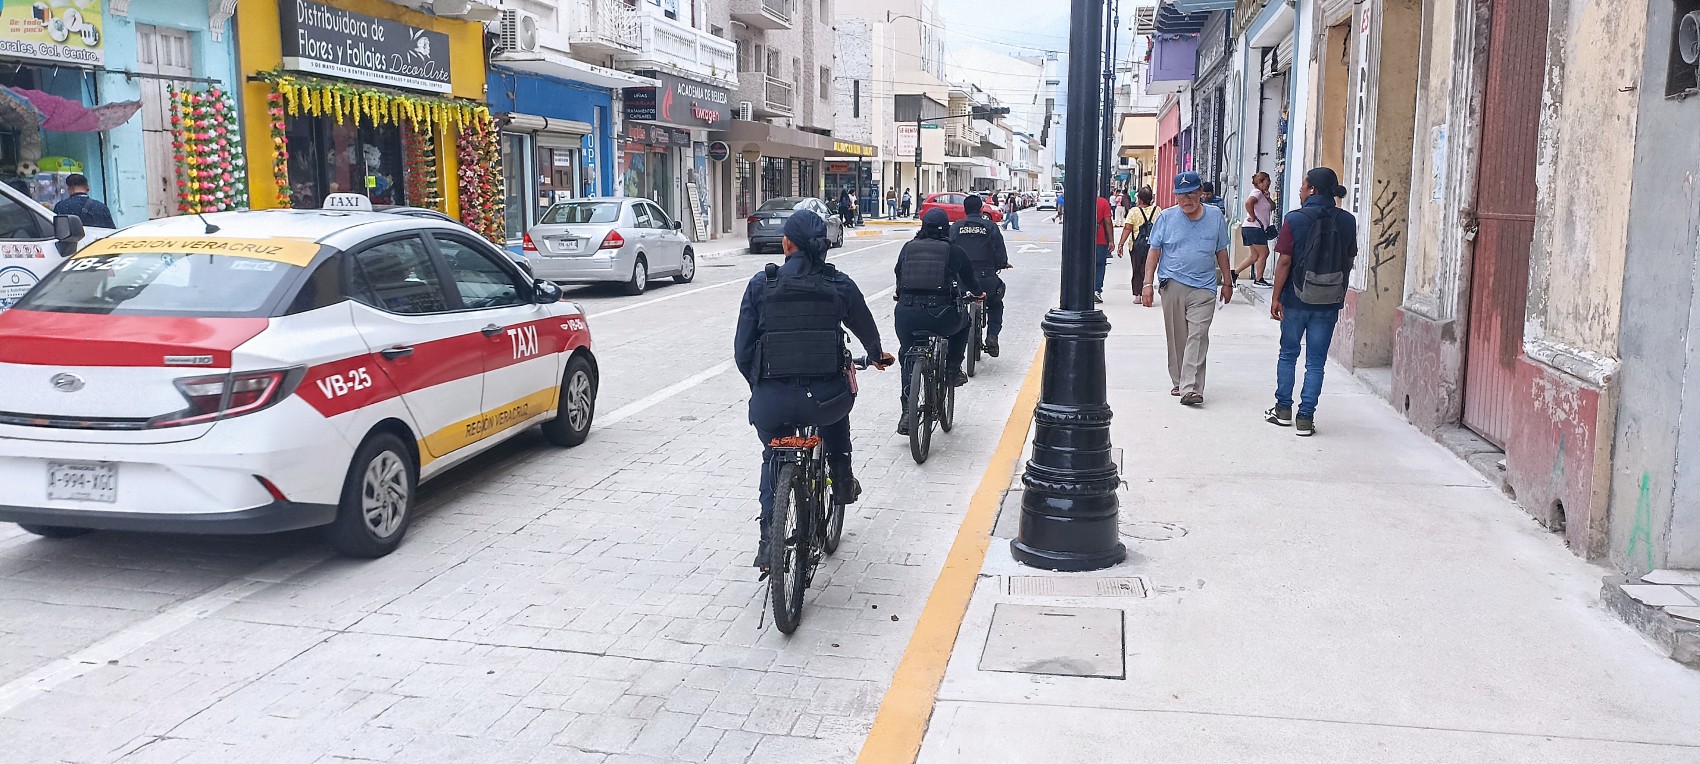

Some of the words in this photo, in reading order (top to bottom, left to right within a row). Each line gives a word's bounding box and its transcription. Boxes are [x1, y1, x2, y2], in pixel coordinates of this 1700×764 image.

[297, 0, 367, 38] Distribuidora
[371, 18, 385, 42] de
[39, 43, 61, 58] Col.
[63, 46, 100, 62] Centro.
[298, 29, 333, 60] Flores
[337, 45, 343, 65] y
[347, 40, 387, 71] Follajes
[389, 53, 450, 82] DecorArte
[677, 82, 704, 100] ACADEMIA
[704, 88, 711, 101] DE
[711, 90, 728, 105] BELLEZA
[330, 196, 359, 207] TAXI
[107, 240, 178, 250] REGION
[181, 240, 284, 255] VERACRUZ
[61, 256, 138, 272] VB-25
[507, 325, 538, 360] TAXI
[316, 366, 373, 400] VB-25
[495, 403, 529, 427] VERACRUZ
